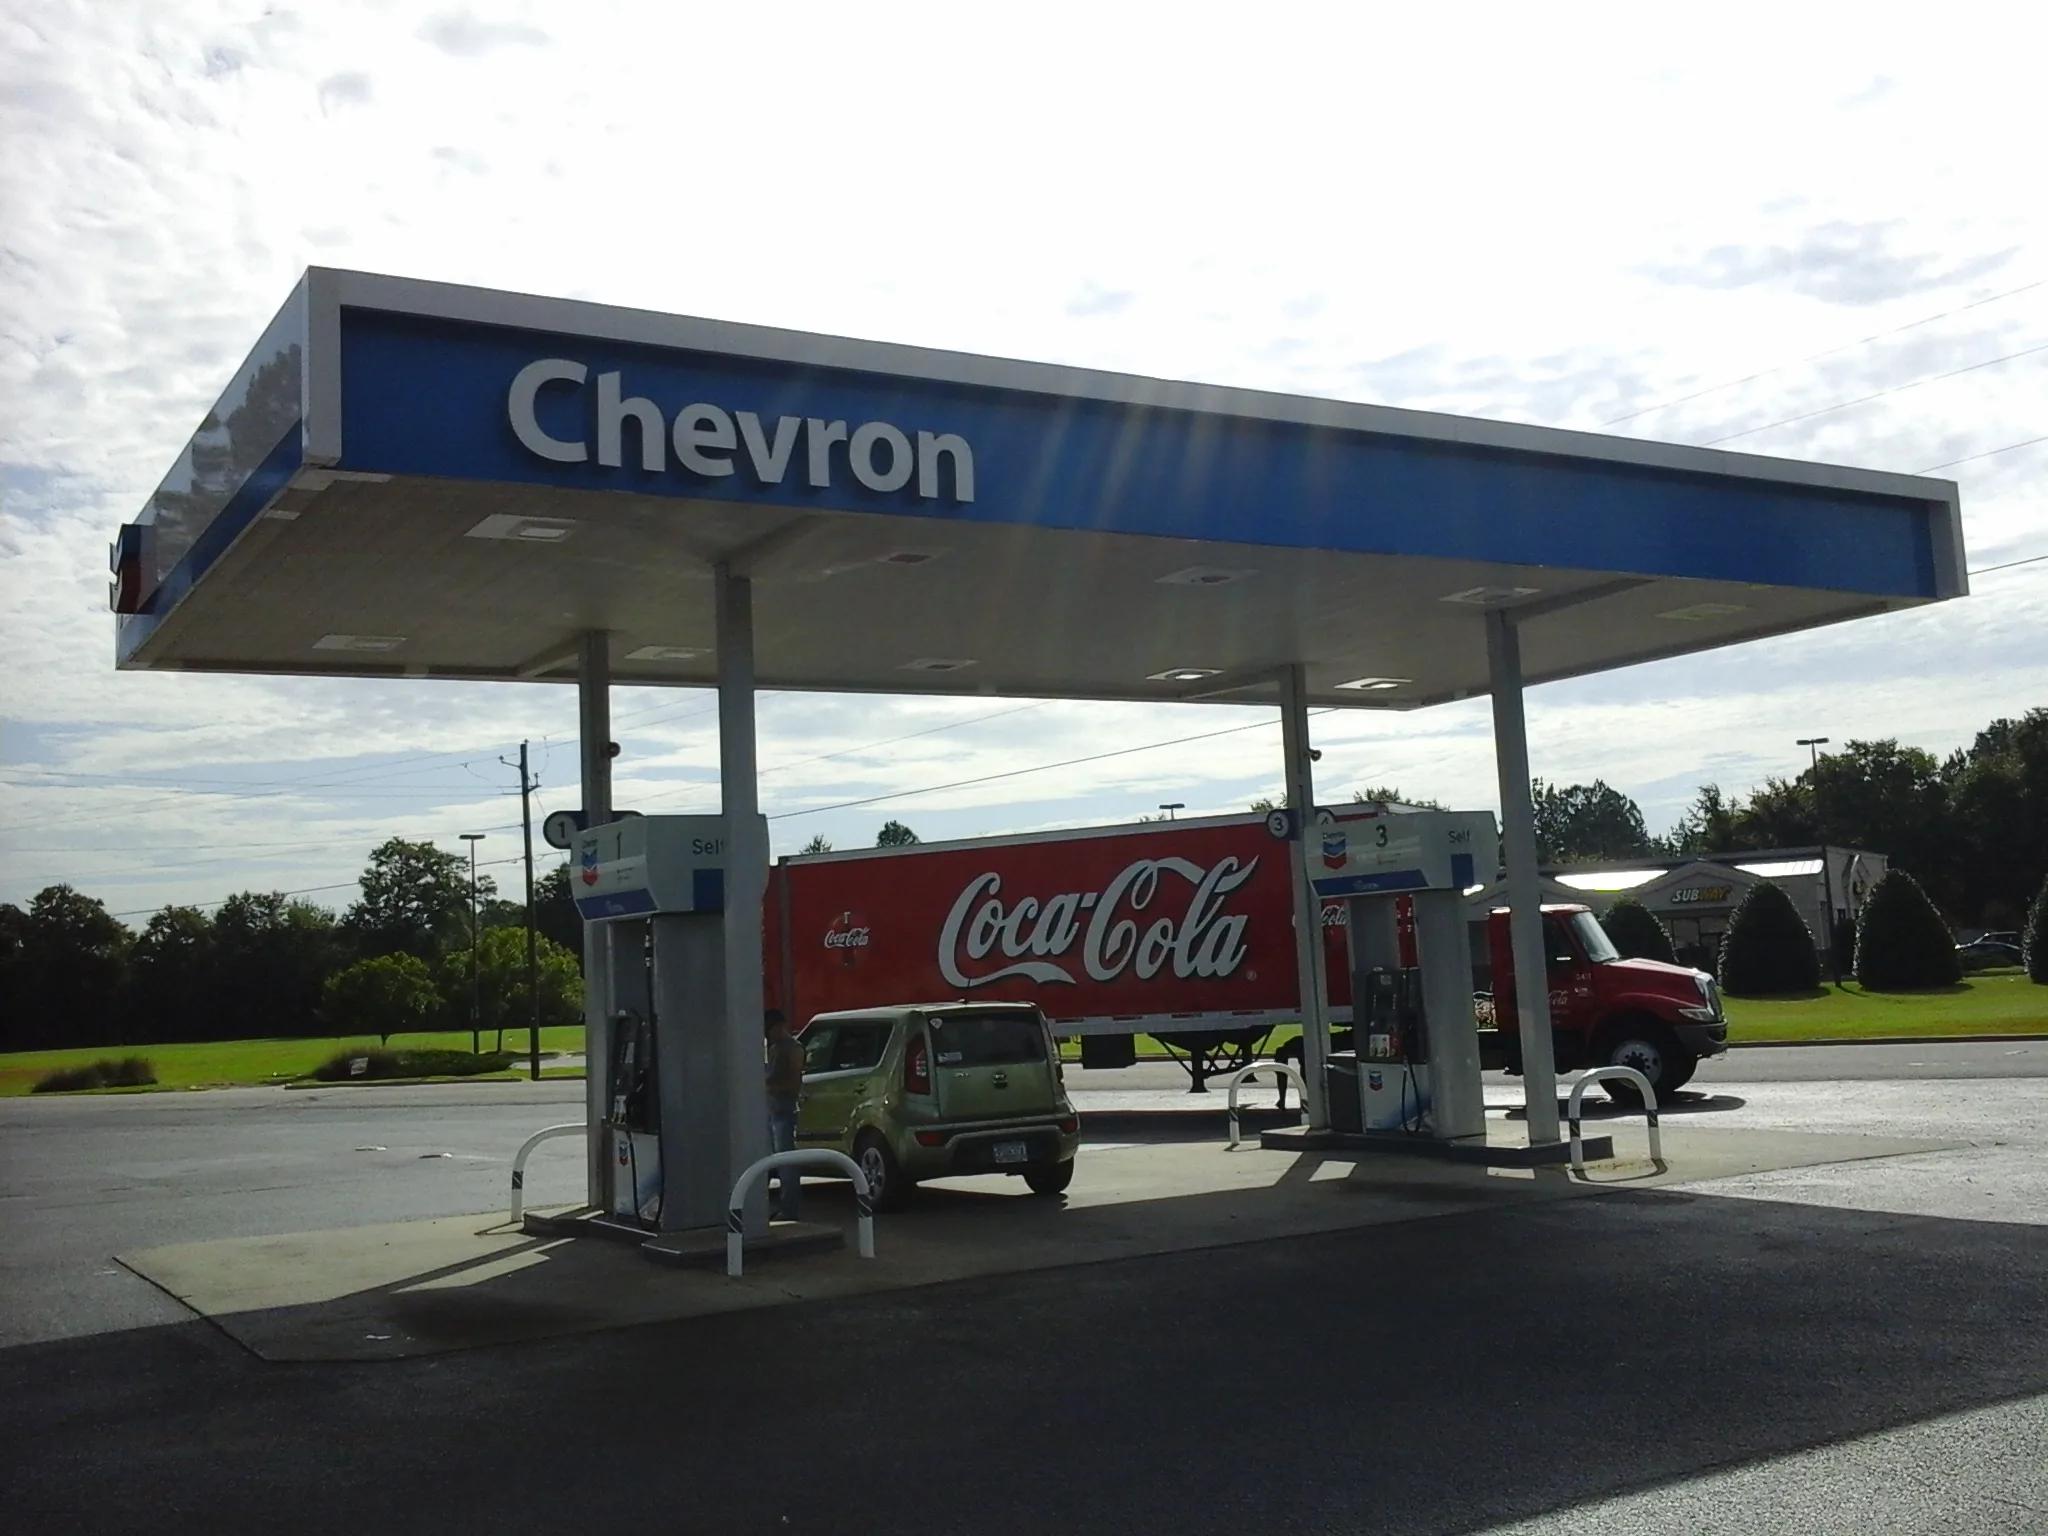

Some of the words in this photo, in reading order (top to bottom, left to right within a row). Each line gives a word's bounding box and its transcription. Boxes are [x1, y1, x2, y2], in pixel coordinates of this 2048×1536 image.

[508, 358, 975, 502] Chevron
[558, 822, 565, 838] 1
[1274, 817, 1284, 831] 3
[1375, 824, 1388, 848] 3
[1448, 828, 1470, 843] Self
[1672, 886, 1732, 902] SUBWAY
[938, 854, 1259, 988] Coca-Cola
